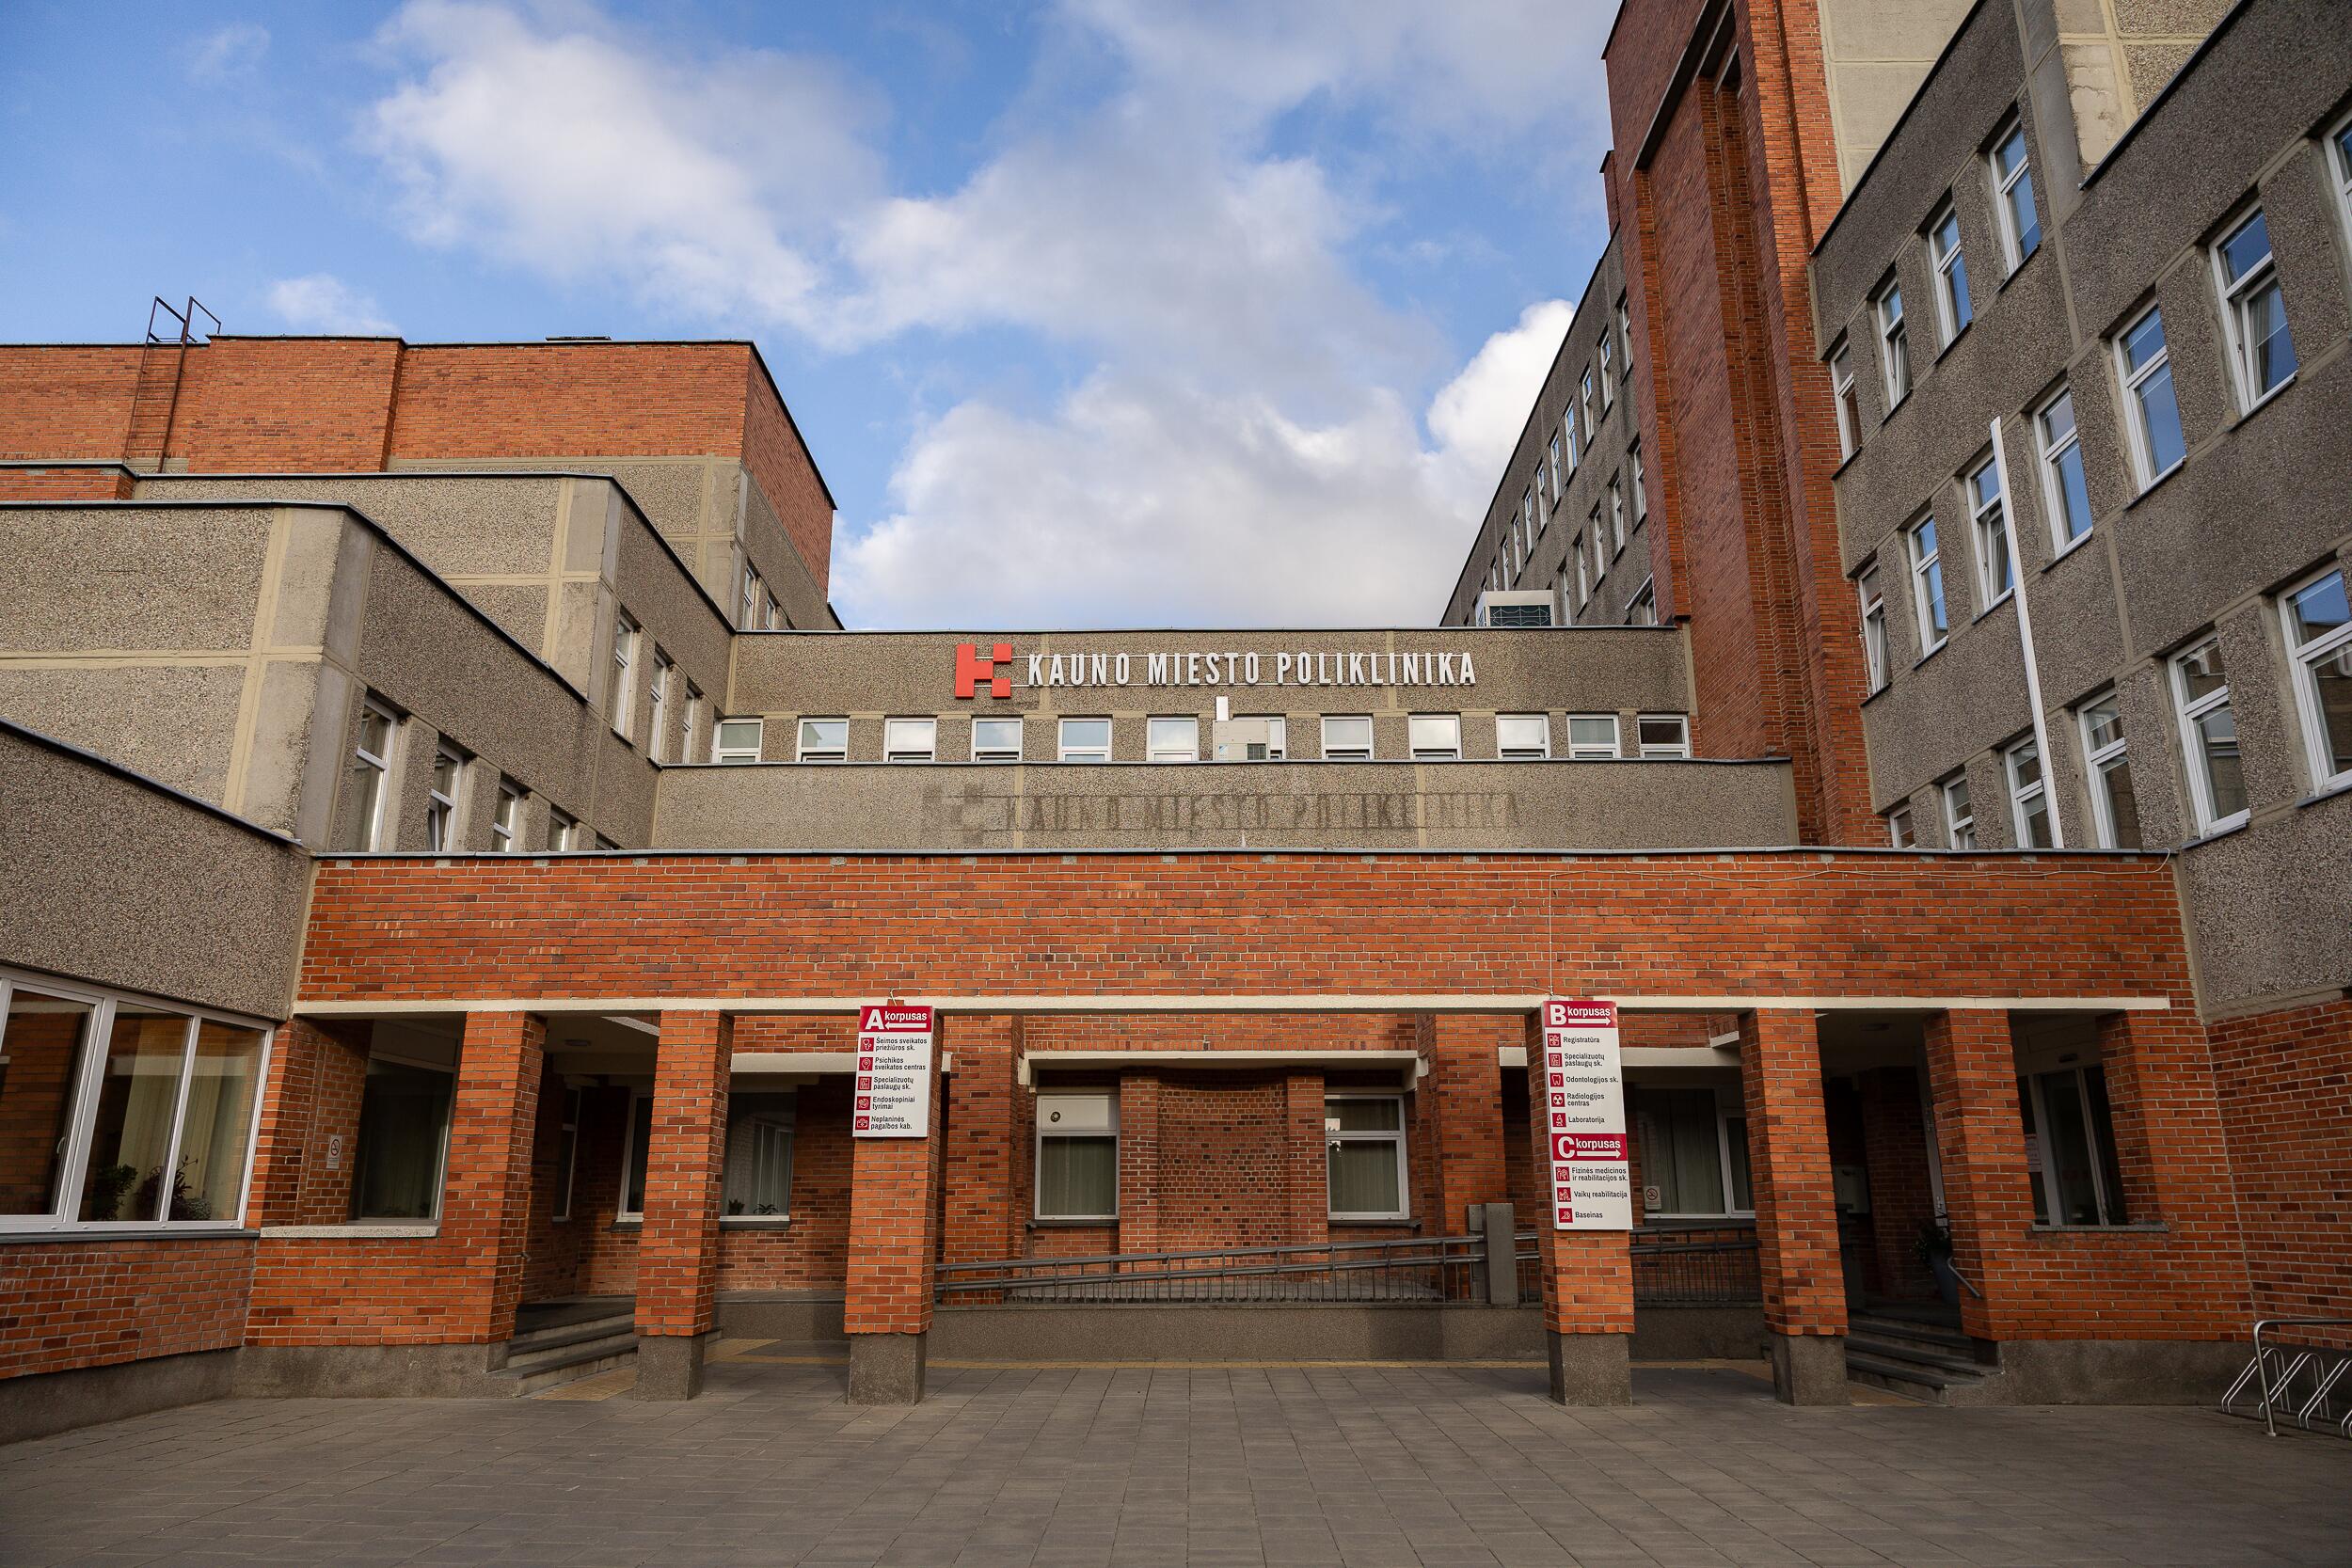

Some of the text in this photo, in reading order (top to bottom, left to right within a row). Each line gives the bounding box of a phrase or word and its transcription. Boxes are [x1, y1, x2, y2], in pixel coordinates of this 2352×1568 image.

[1028, 652, 1476, 687] KAUNO MIESTO POLIKLINIKA
[865, 1008, 928, 1030] A korpusas
[1549, 1004, 1611, 1025] B korpusas
[1565, 1059, 1593, 1068] paslaugų
[1566, 1093, 1605, 1101] Radiologijos
[1558, 1135, 1621, 1159] C korpusas
[1578, 1174, 1617, 1182] reabilitacijos
[1573, 1190, 1628, 1199] Vaikų reabilitacija
